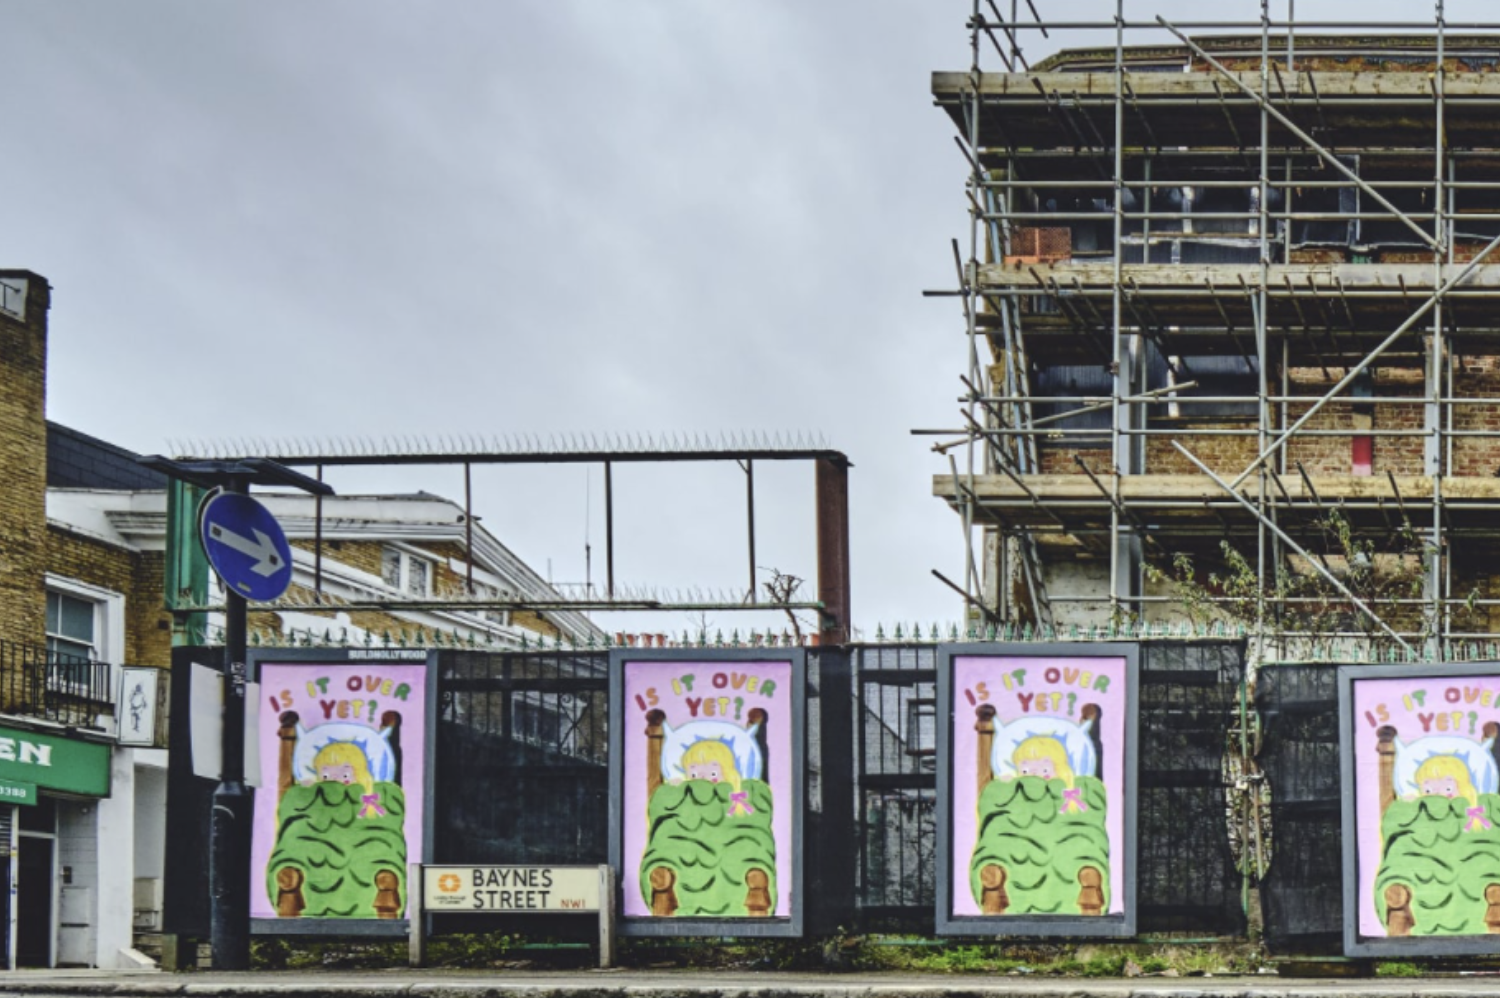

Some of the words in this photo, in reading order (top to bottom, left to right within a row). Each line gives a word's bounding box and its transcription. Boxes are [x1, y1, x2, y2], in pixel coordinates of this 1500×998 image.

[269, 690, 293, 712] IS
[306, 677, 330, 698] IT
[347, 675, 411, 701] OVER
[635, 688, 659, 711] IS
[671, 674, 695, 696] IT
[712, 672, 777, 698] OVER
[965, 682, 990, 706] IS
[1002, 668, 1027, 691] IT
[1044, 667, 1111, 693] OVER
[320, 700, 377, 723] YET?
[686, 697, 744, 720] YET?
[1018, 691, 1077, 716] YET?
[1365, 704, 1390, 728] IS
[1402, 689, 1427, 711] IT
[1418, 711, 1478, 735] YET?
[472, 868, 554, 888] BAYNES
[473, 890, 551, 910] STREET
[560, 899, 587, 909] NW1
